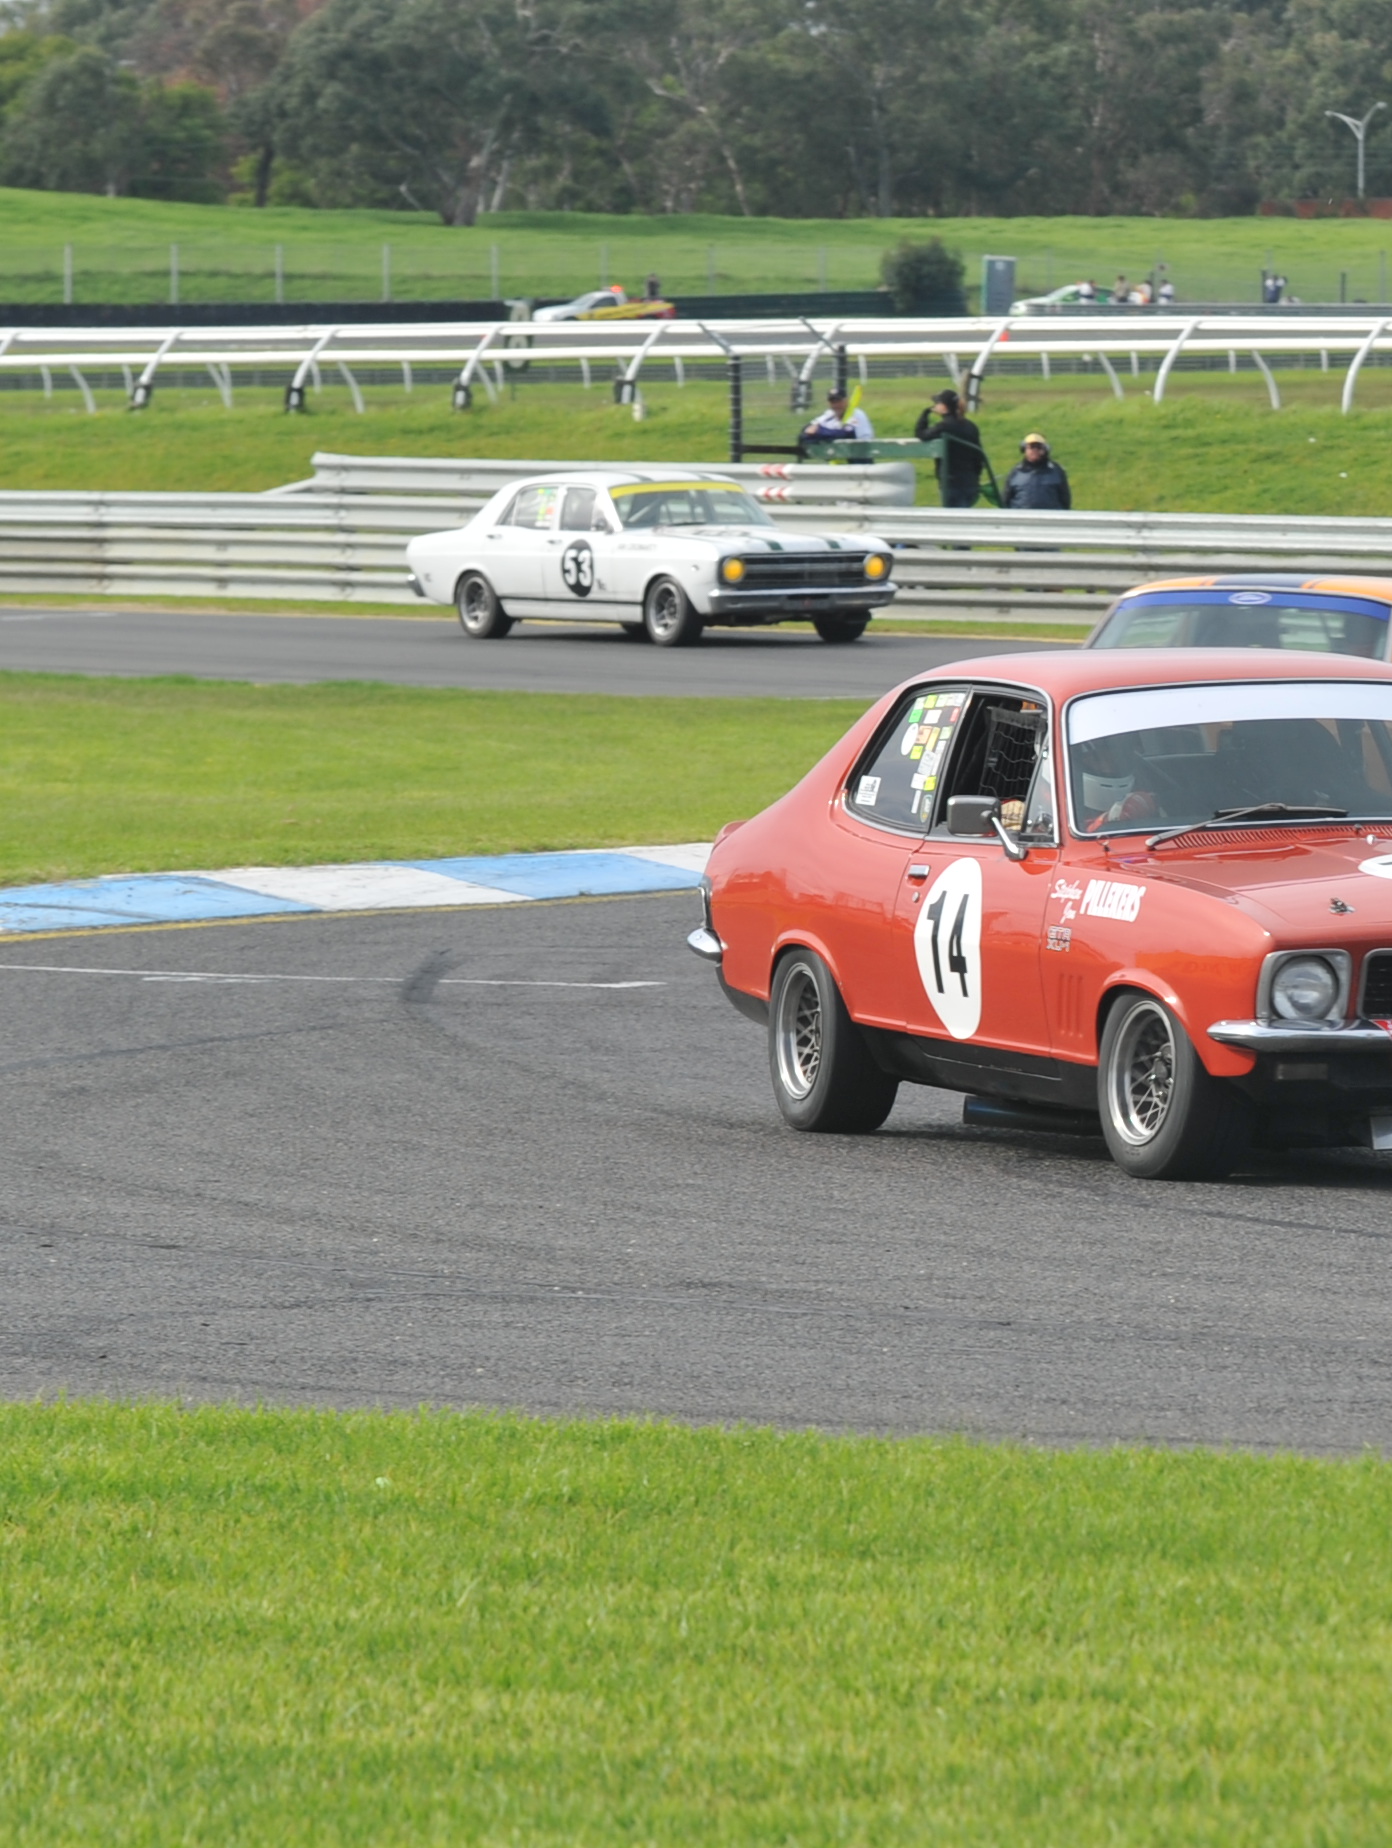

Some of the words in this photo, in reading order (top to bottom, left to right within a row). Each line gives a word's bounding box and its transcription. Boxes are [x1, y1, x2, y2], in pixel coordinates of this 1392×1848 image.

[564, 549, 592, 587] 53
[1079, 879, 1147, 922] PILLEKERS
[927, 890, 969, 998] 14
